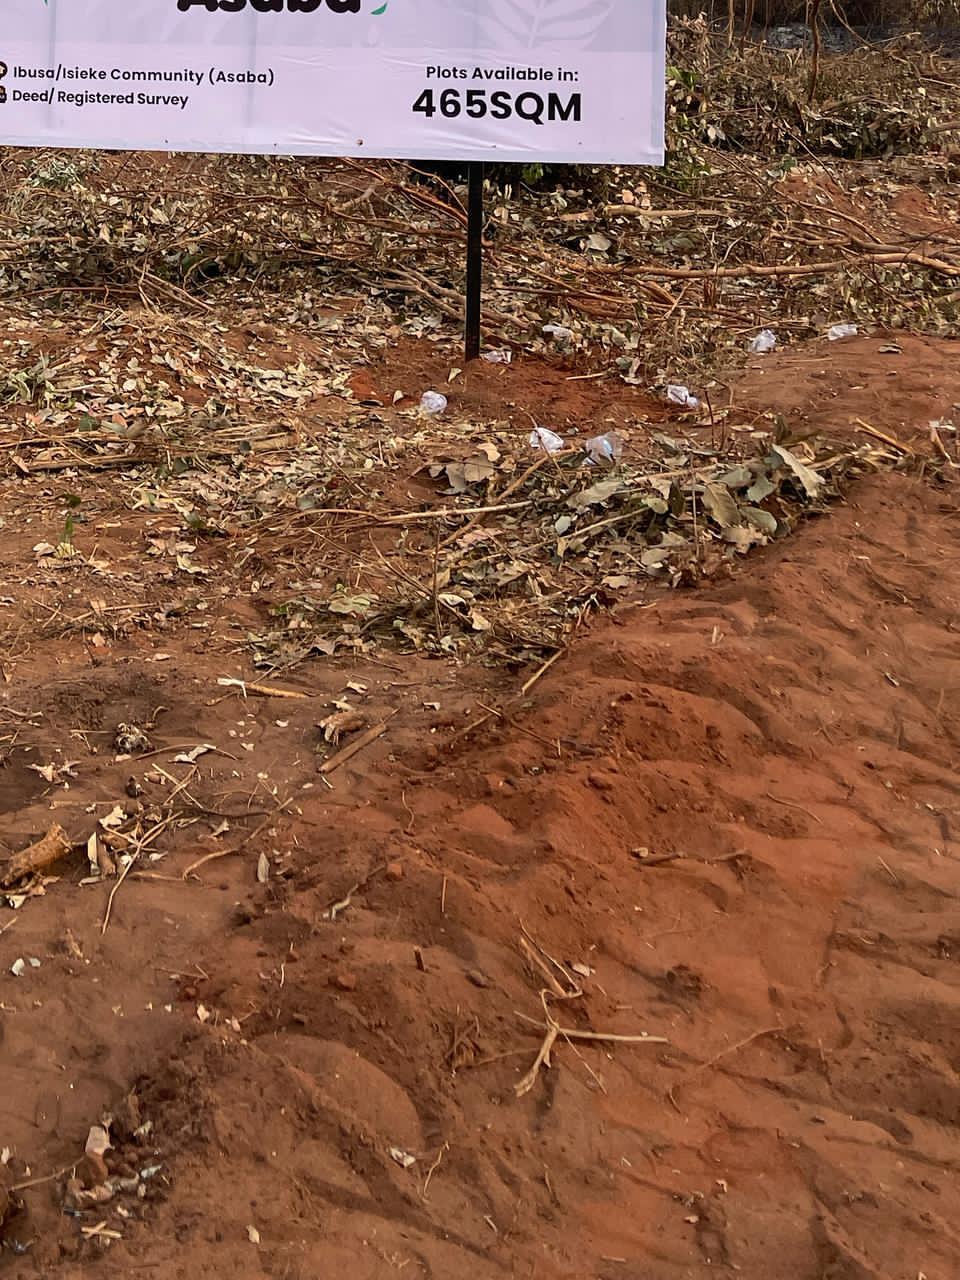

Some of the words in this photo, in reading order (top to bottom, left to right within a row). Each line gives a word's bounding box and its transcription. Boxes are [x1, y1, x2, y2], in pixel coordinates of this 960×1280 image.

[13, 64, 107, 81] Ibusa/Isieke
[110, 68, 204, 86] Community
[208, 67, 274, 86] (Asaba)
[426, 66, 467, 79] Plots
[471, 66, 553, 81] Available
[557, 67, 579, 82] in:
[12, 87, 54, 105] Deed/
[57, 90, 134, 108] Registered
[137, 92, 189, 110] Survey
[412, 88, 581, 125] 465SQM
